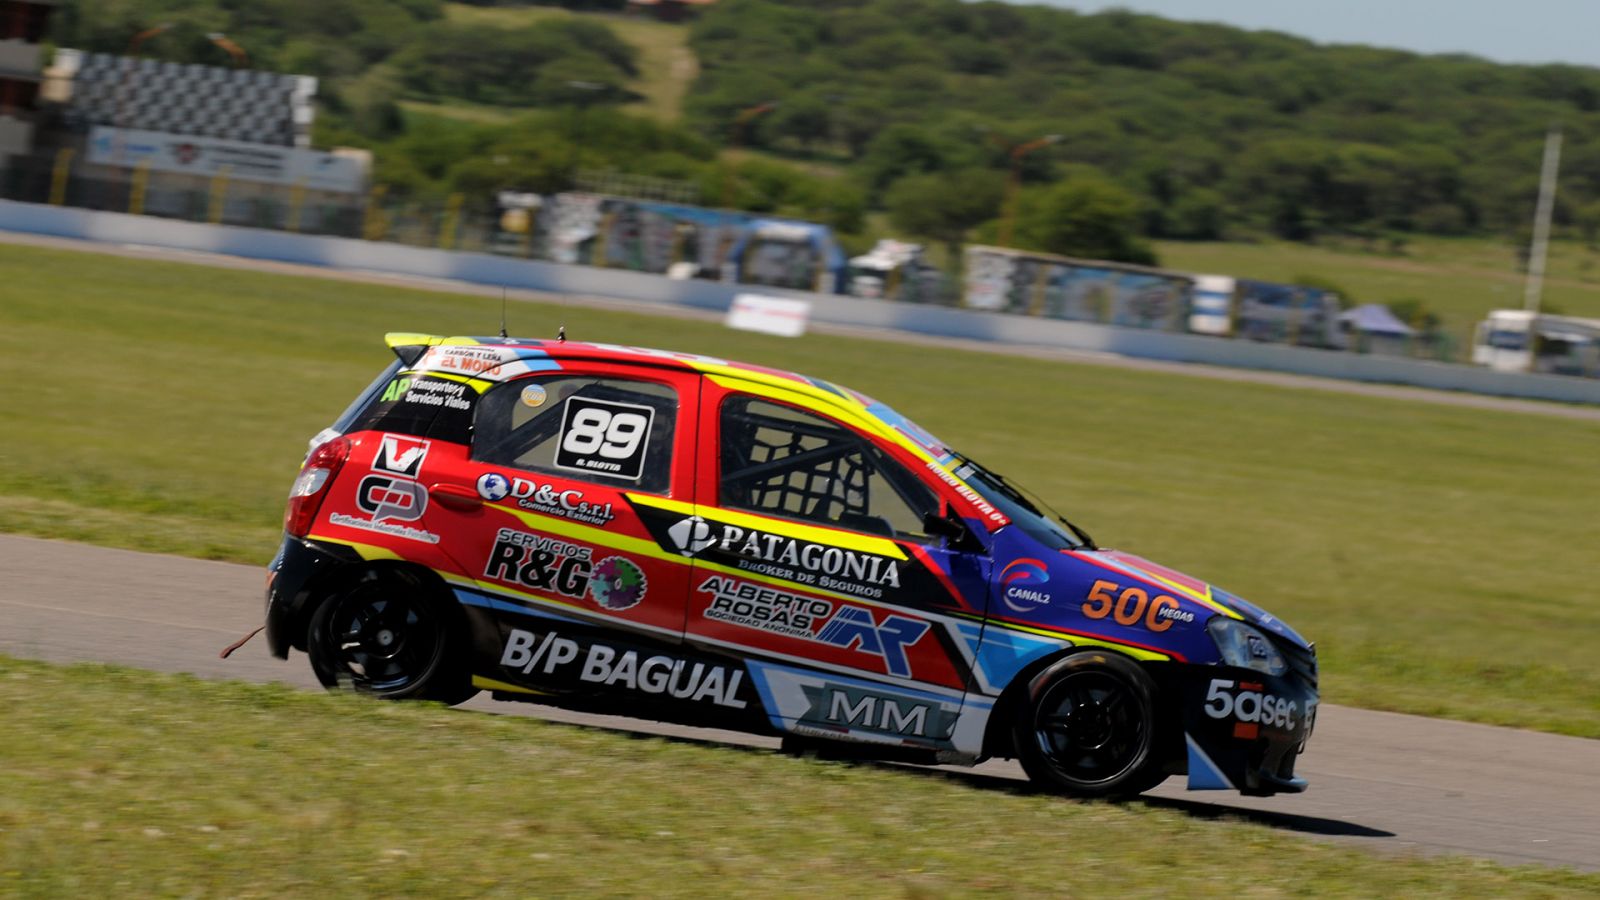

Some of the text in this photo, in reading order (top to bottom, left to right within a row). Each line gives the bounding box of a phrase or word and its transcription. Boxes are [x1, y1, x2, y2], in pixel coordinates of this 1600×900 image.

[461, 358, 501, 376] MONO
[380, 378, 411, 402] AP
[405, 391, 444, 406] Servicios
[562, 407, 648, 459] 89
[586, 460, 622, 472] BLOTTA
[518, 499, 606, 526] Comercio Exterior
[499, 529, 592, 560] SERVICIOS
[719, 524, 901, 588] PATAGONIA
[485, 540, 593, 599] R&G
[797, 571, 815, 584] DE
[698, 576, 832, 617] ALBERTO
[703, 608, 815, 639] SOCIEDAD ANONIMA
[712, 596, 813, 630] ROSAS
[1158, 606, 1195, 624] MEGAS
[501, 628, 748, 708] B/P BAGUAL
[827, 689, 929, 737] MM
